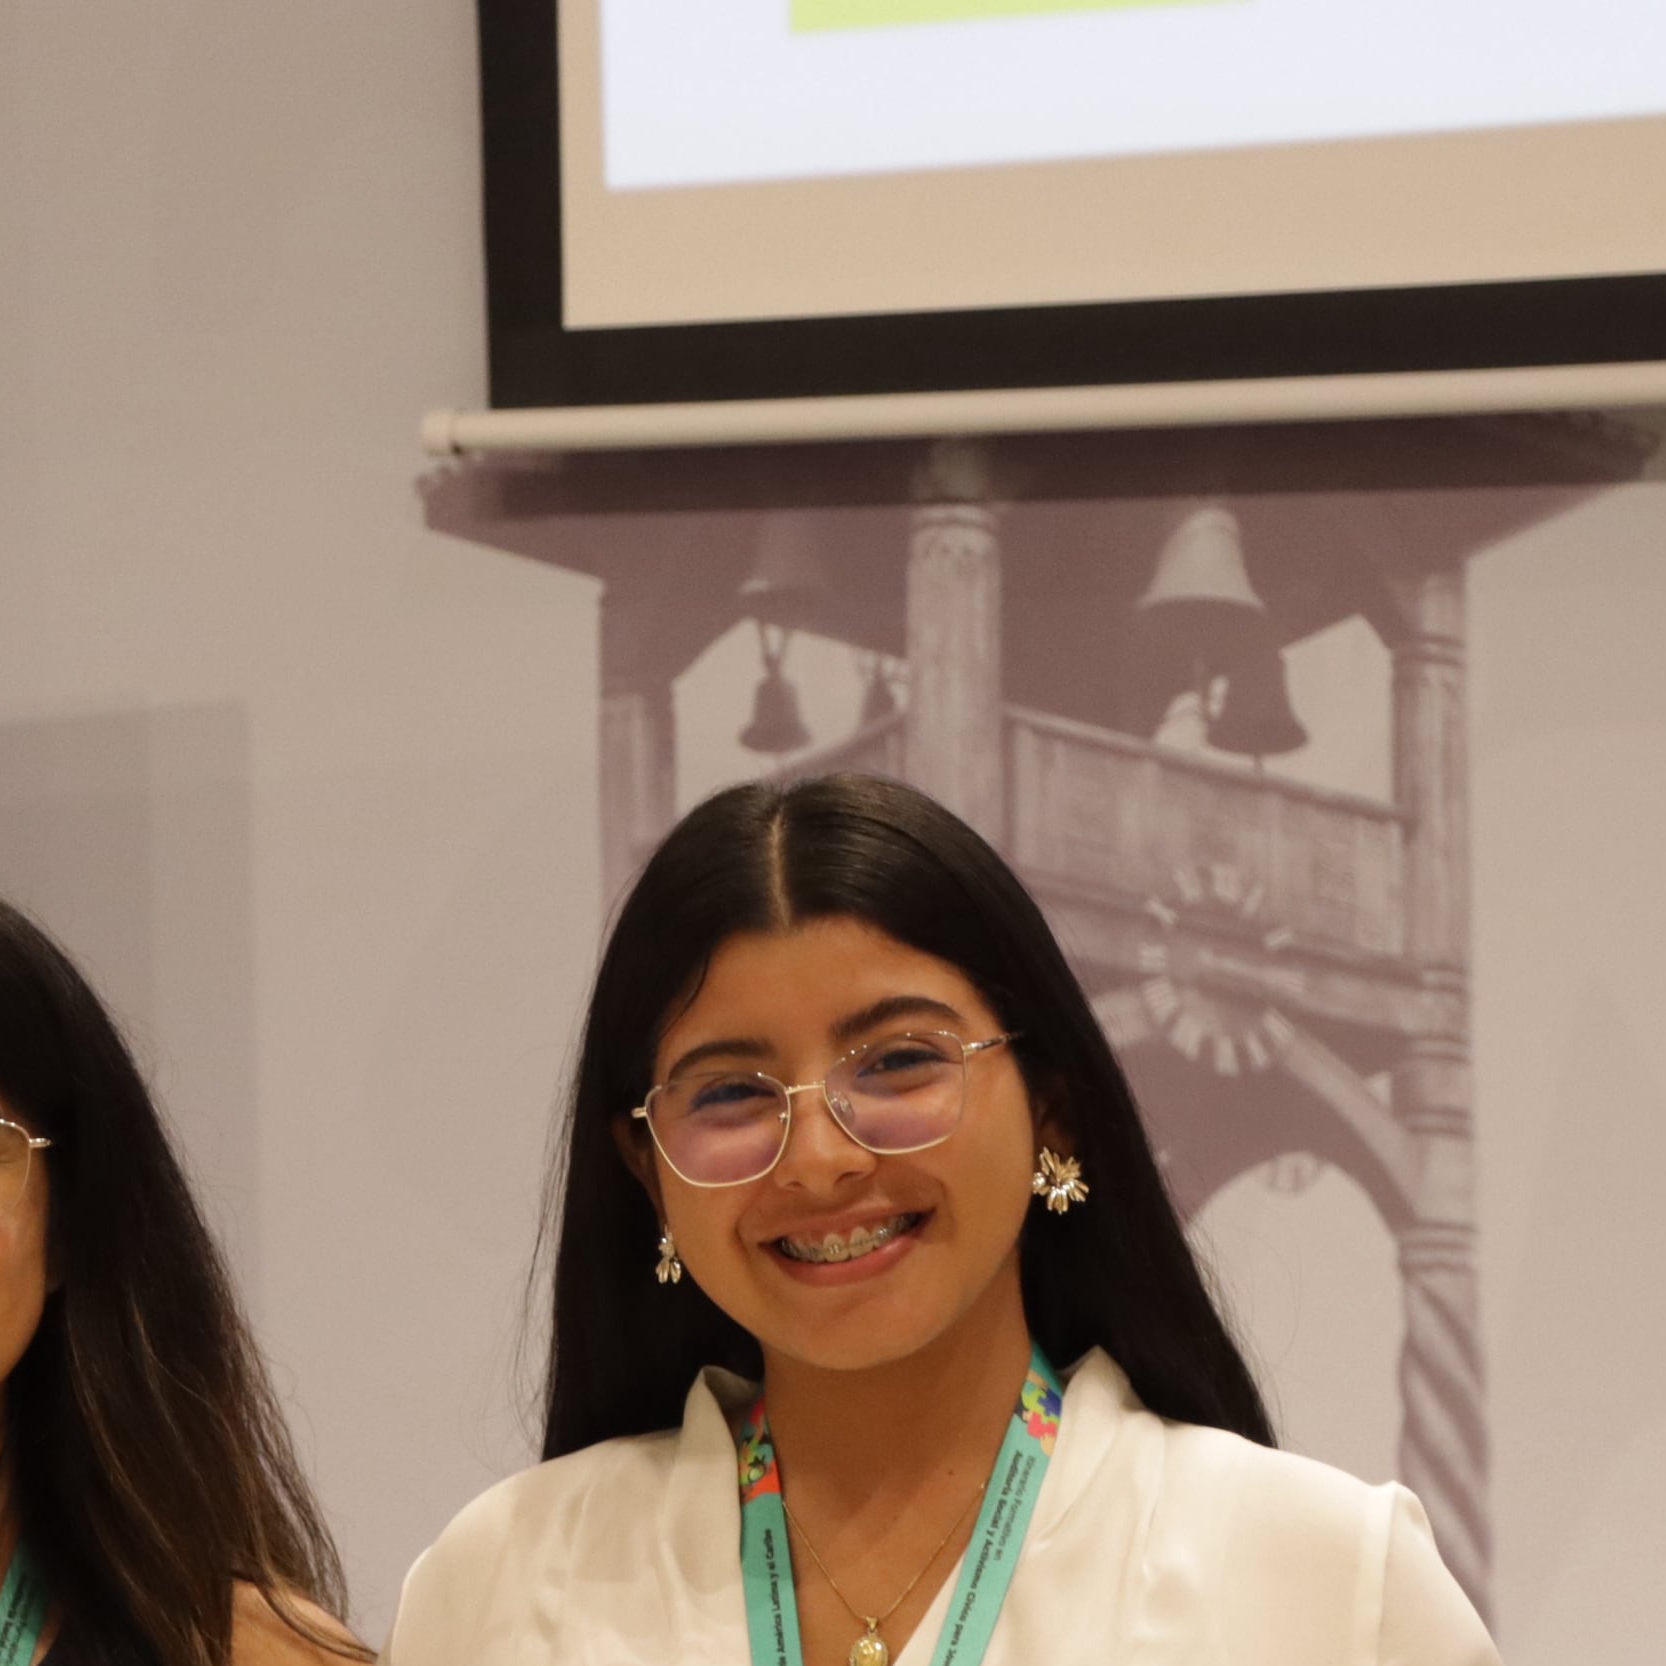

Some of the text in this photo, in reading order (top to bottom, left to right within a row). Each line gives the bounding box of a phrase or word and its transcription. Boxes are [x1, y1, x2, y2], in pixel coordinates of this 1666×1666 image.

[1000, 1449, 1025, 1497] Auditoría
[989, 1498, 1008, 1529] Social
[998, 1497, 1022, 1547] Formativo
[969, 1538, 994, 1590] Activismo
[993, 1548, 1004, 1562] en
[958, 1591, 977, 1622] Cívico
[948, 1622, 964, 1646] para
